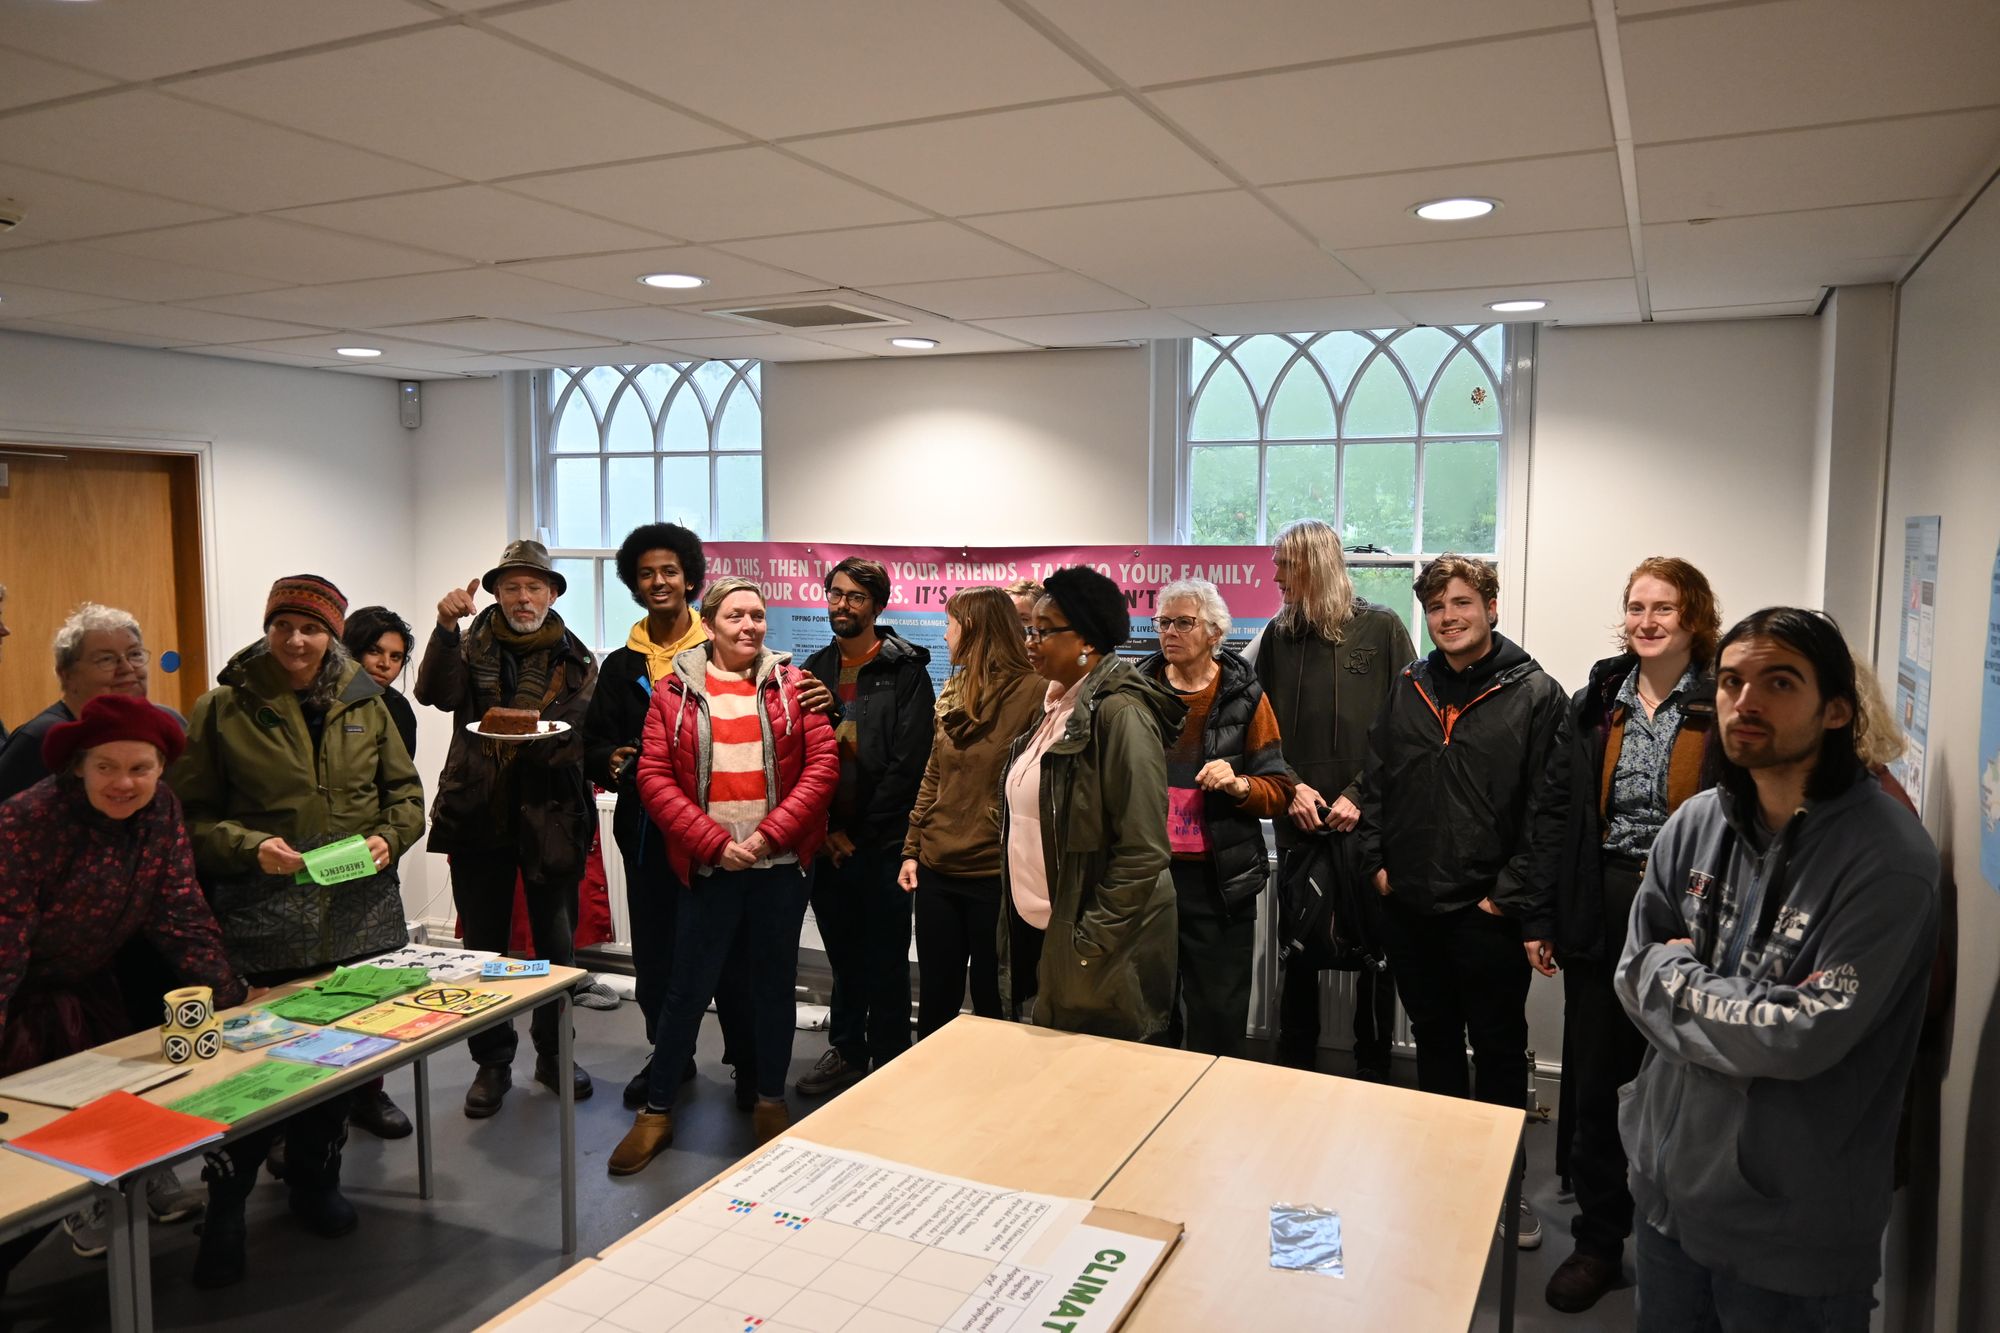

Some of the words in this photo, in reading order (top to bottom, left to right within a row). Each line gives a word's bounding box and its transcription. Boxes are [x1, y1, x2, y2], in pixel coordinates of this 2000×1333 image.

[704, 556, 732, 575] EAD
[735, 558, 764, 579] THIS,
[769, 559, 808, 577] THEN
[891, 562, 941, 581] YOUR
[1118, 564, 1172, 583] YOUR
[1181, 564, 1261, 588] FAMILY,
[915, 586, 947, 604] IT'S
[1126, 590, 1156, 609] N'T
[319, 860, 366, 878] EMERGENCY
